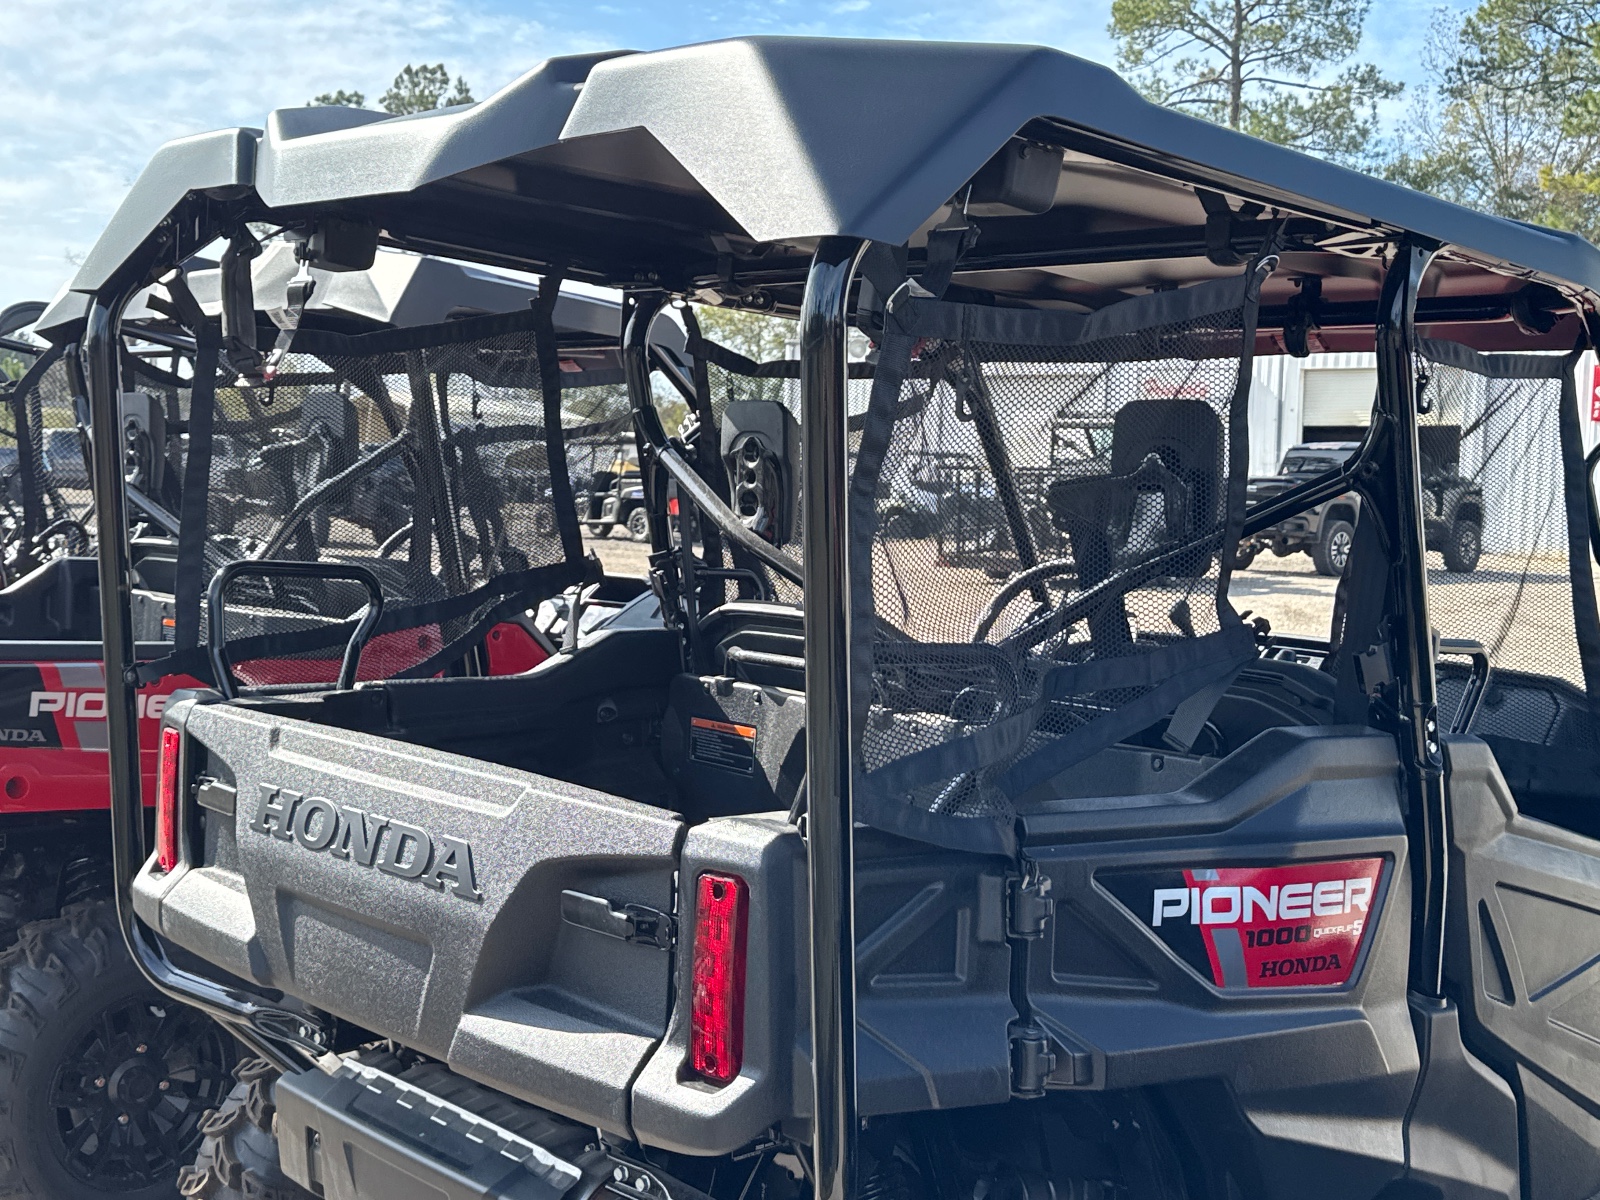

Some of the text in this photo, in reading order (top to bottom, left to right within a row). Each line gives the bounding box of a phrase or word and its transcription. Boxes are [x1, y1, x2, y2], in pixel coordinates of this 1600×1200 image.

[250, 783, 483, 901] HONDA
[1152, 877, 1372, 927] PIONEER
[1246, 925, 1311, 948] 1000
[1259, 954, 1342, 978] HONDA
